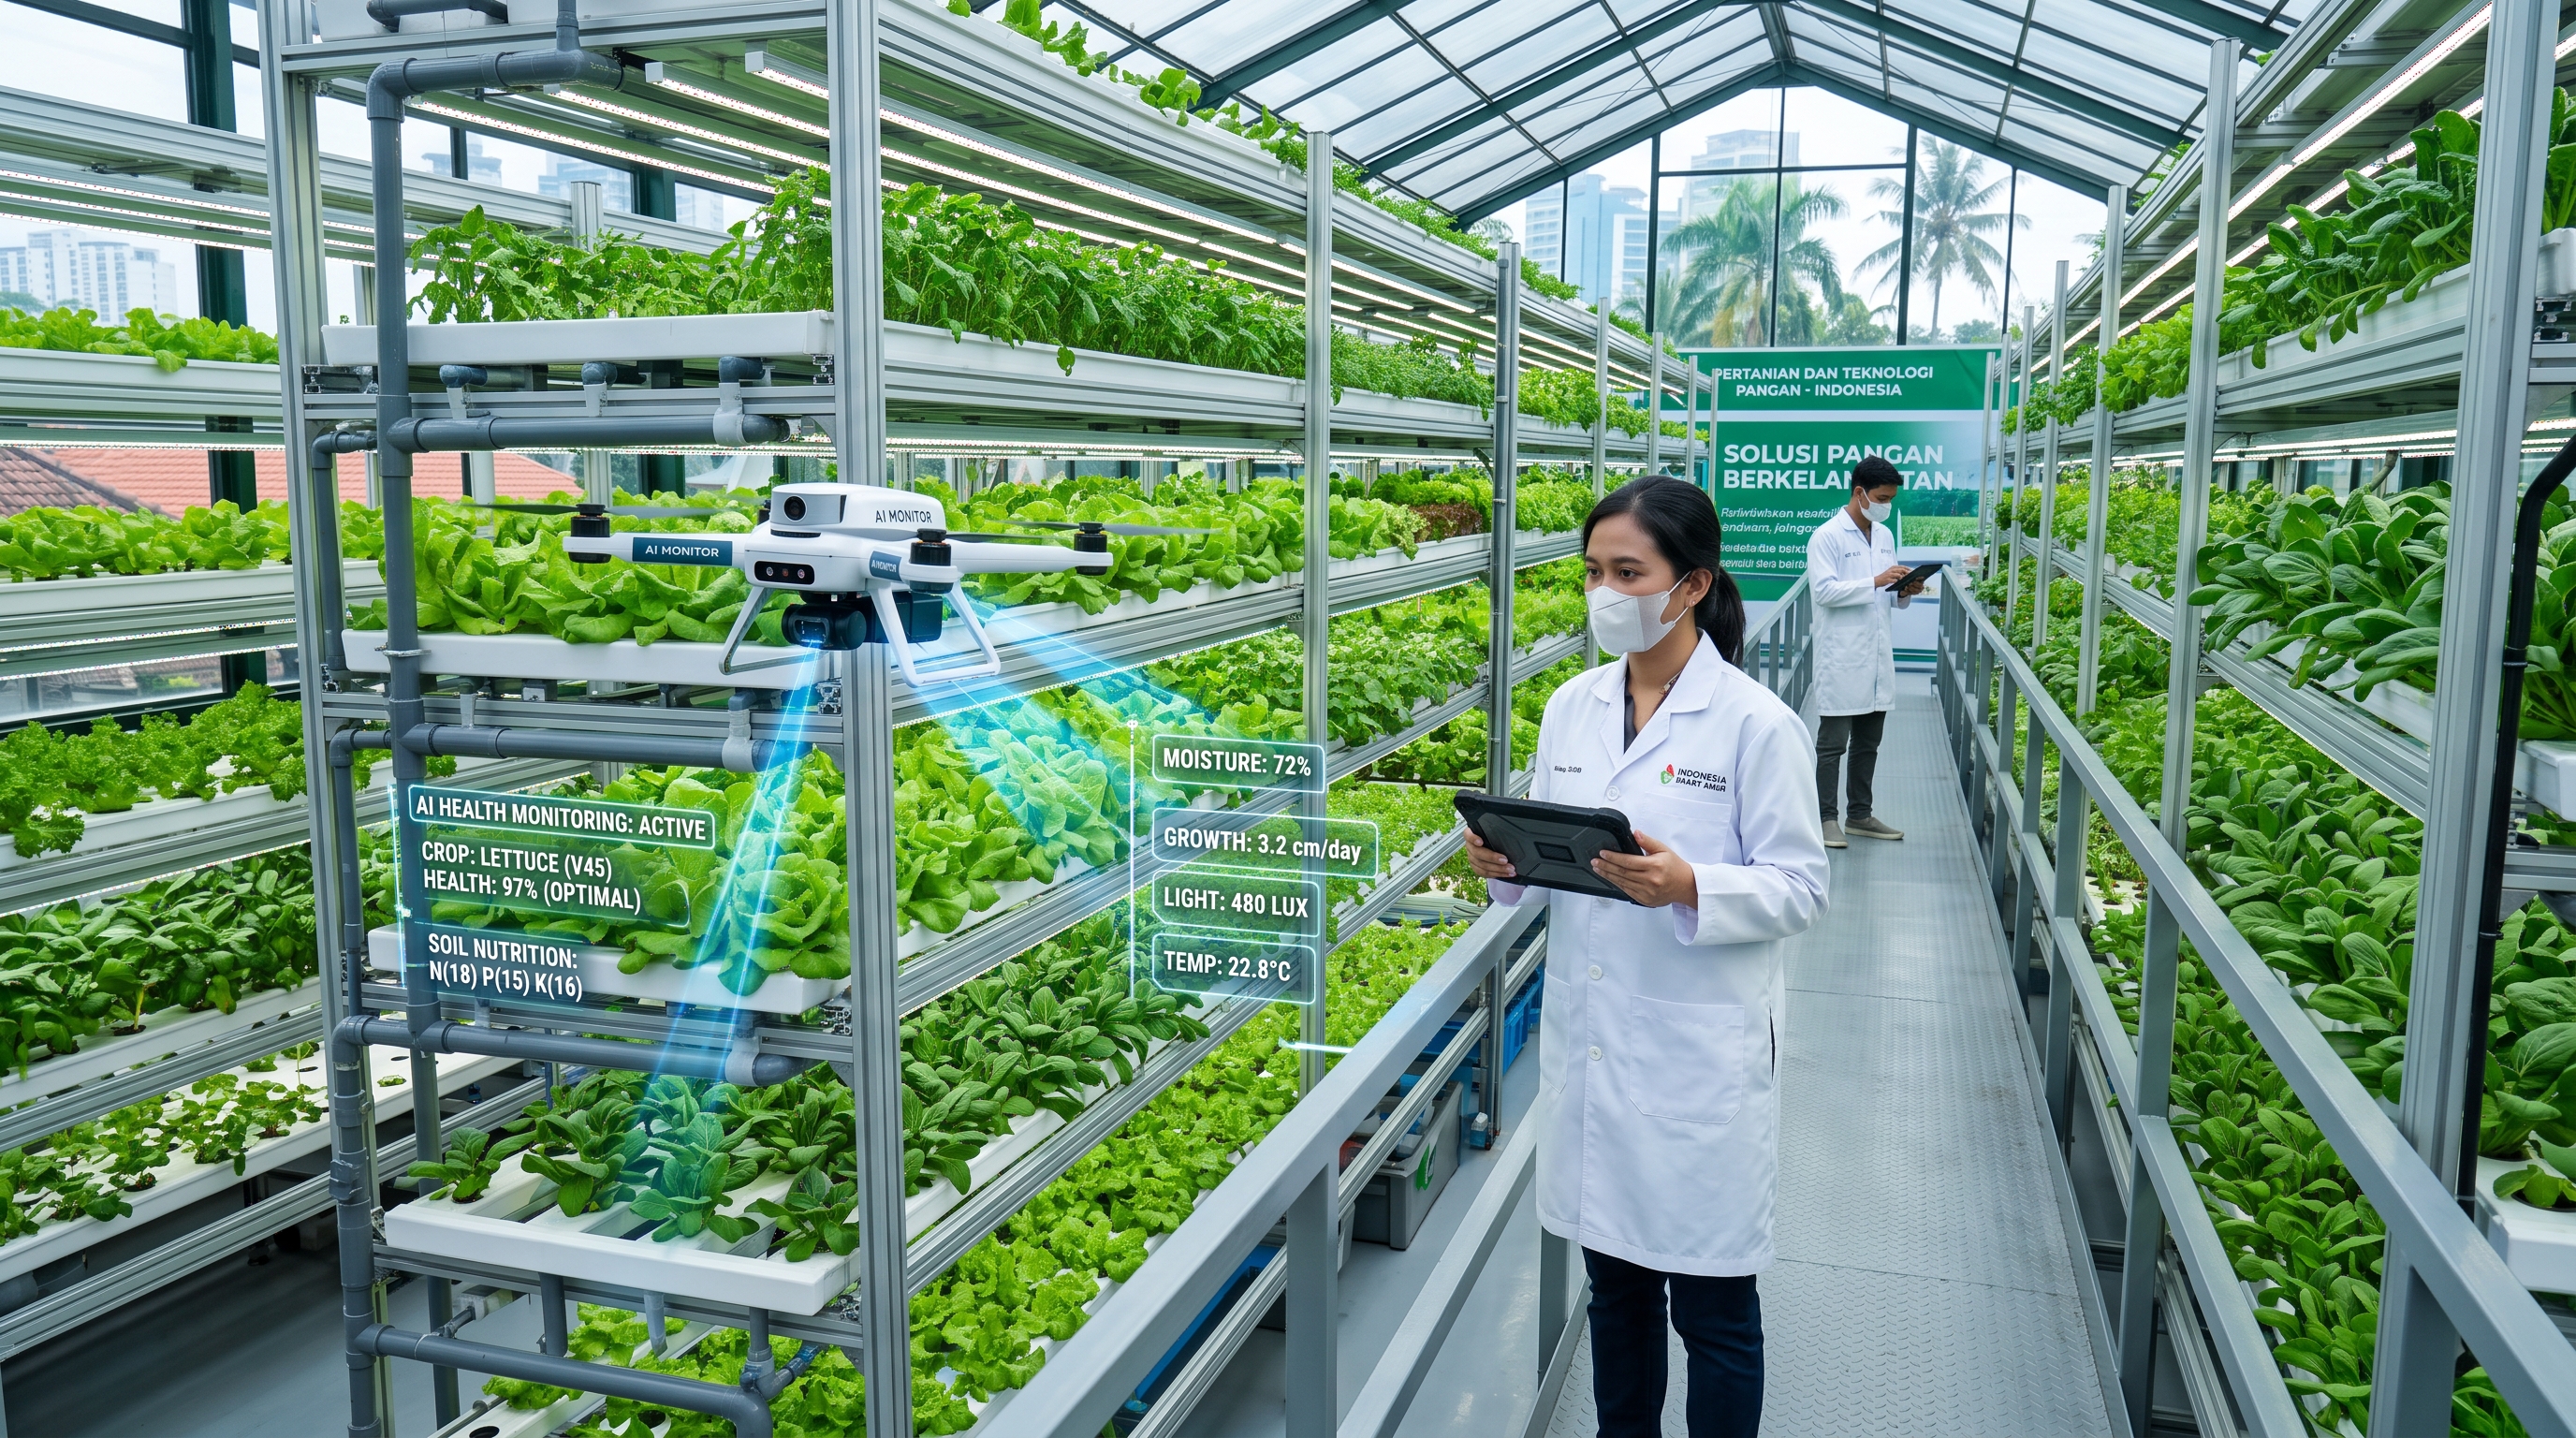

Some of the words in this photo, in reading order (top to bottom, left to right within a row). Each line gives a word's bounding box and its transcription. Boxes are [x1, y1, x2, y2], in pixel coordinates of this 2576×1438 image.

[1714, 368, 1800, 380] PERTANIAN
[1804, 367, 1837, 379] DAN
[1842, 366, 1934, 379] TEKNOLOGI
[1735, 384, 1801, 397] PANGAN
[1814, 384, 1902, 396] INDONESIA
[1723, 444, 1819, 464] SOLUSI
[1827, 444, 1943, 464] PANGAN
[1723, 470, 1954, 491] BERKELATAN
[875, 509, 886, 523] AI
[888, 510, 932, 523] MONITOR
[645, 545, 657, 555] AI
[662, 546, 719, 558] MONITOR
[1677, 768, 1727, 784] INDONESIA
